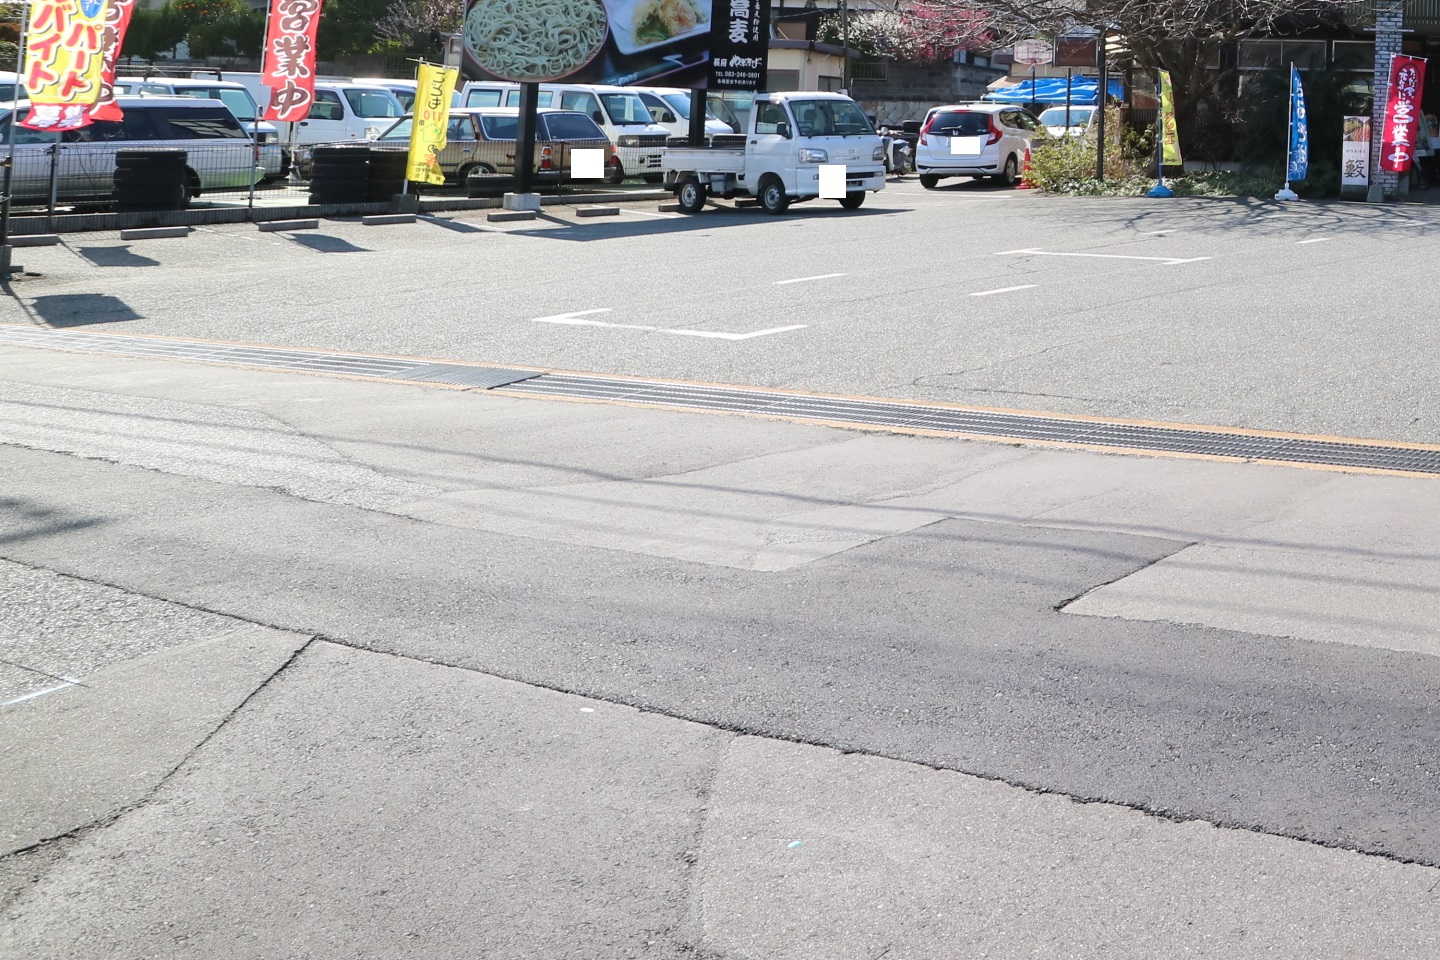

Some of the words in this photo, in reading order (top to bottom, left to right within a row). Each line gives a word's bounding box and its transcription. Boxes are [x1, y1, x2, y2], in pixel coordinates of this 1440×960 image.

[62, 22, 102, 97] パート
[1388, 100, 1414, 169] 営業中
